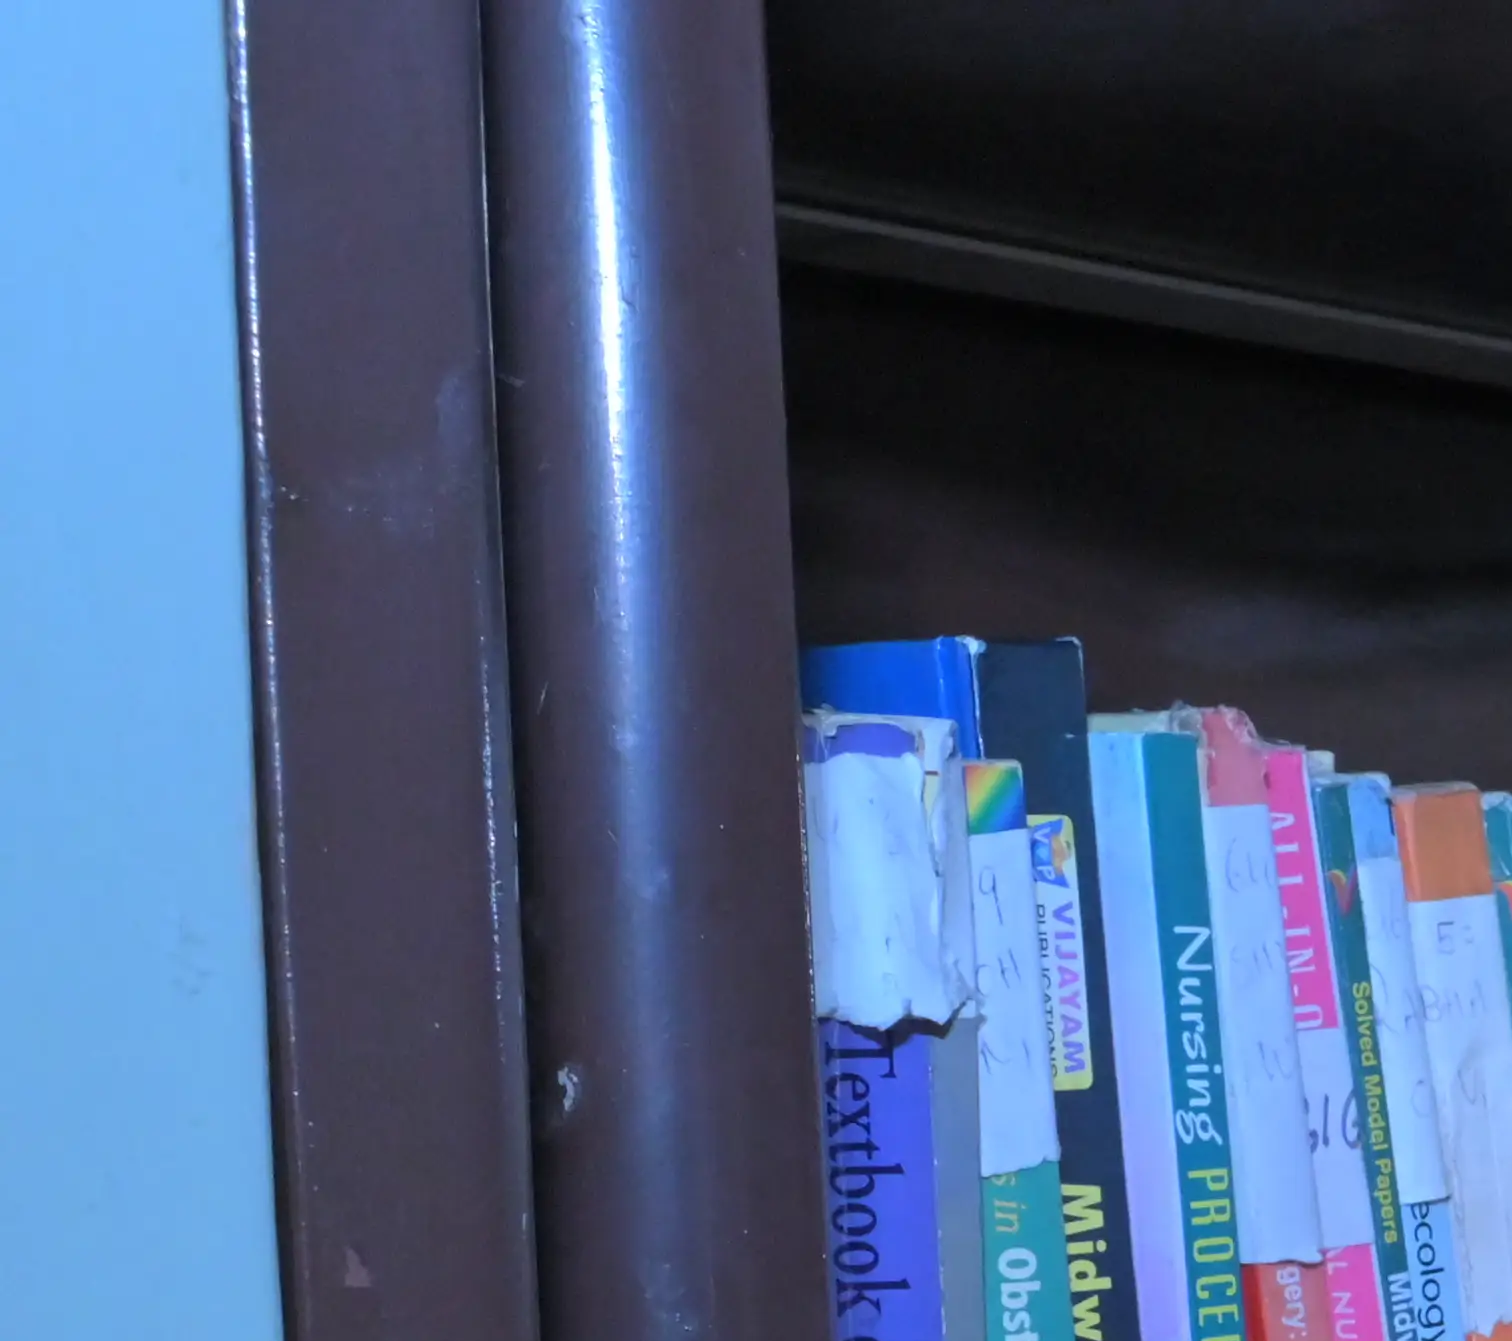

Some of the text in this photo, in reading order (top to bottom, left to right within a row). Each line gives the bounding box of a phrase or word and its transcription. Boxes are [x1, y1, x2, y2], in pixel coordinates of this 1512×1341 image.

[1051, 901, 1087, 1074] VIJAYAM
[1173, 923, 1225, 1147] Nursing
[823, 1039, 911, 1318] Textbook
